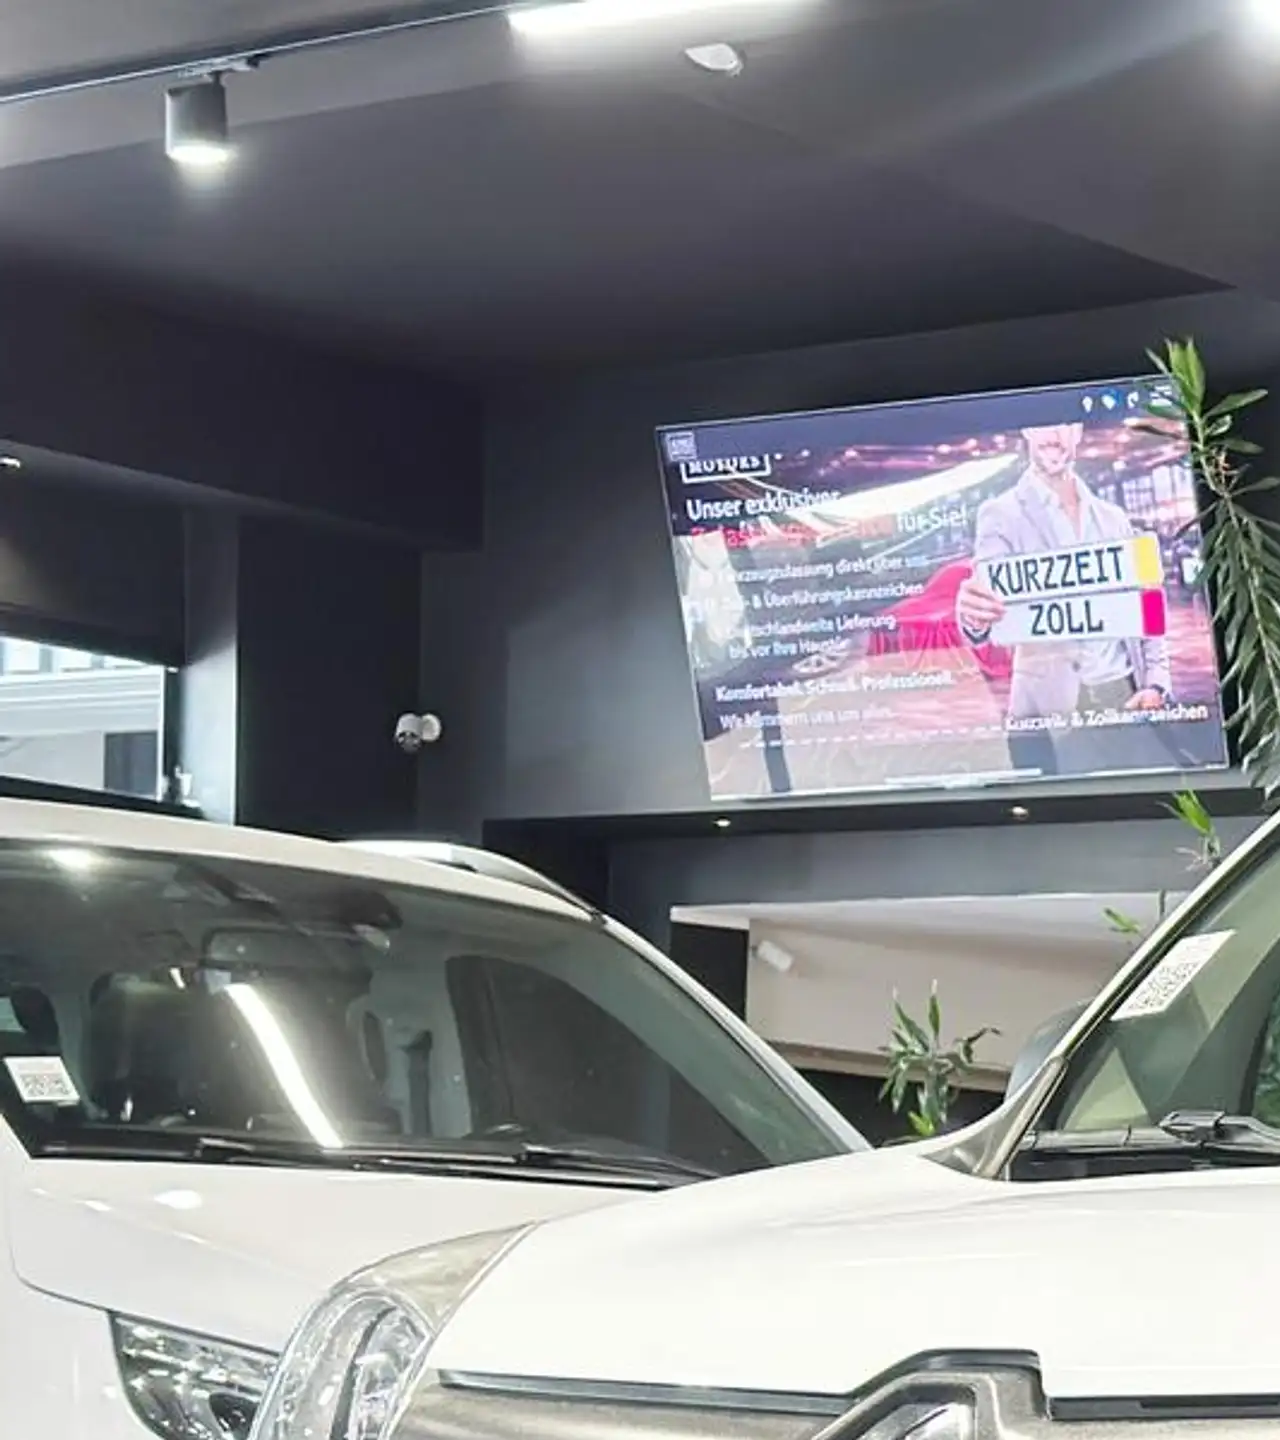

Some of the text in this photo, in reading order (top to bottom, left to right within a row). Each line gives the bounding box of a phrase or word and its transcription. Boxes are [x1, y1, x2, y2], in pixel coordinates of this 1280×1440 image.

[686, 498, 742, 522] Unser
[988, 546, 1124, 597] KURZZEIT
[1029, 599, 1104, 636] ZOLL
